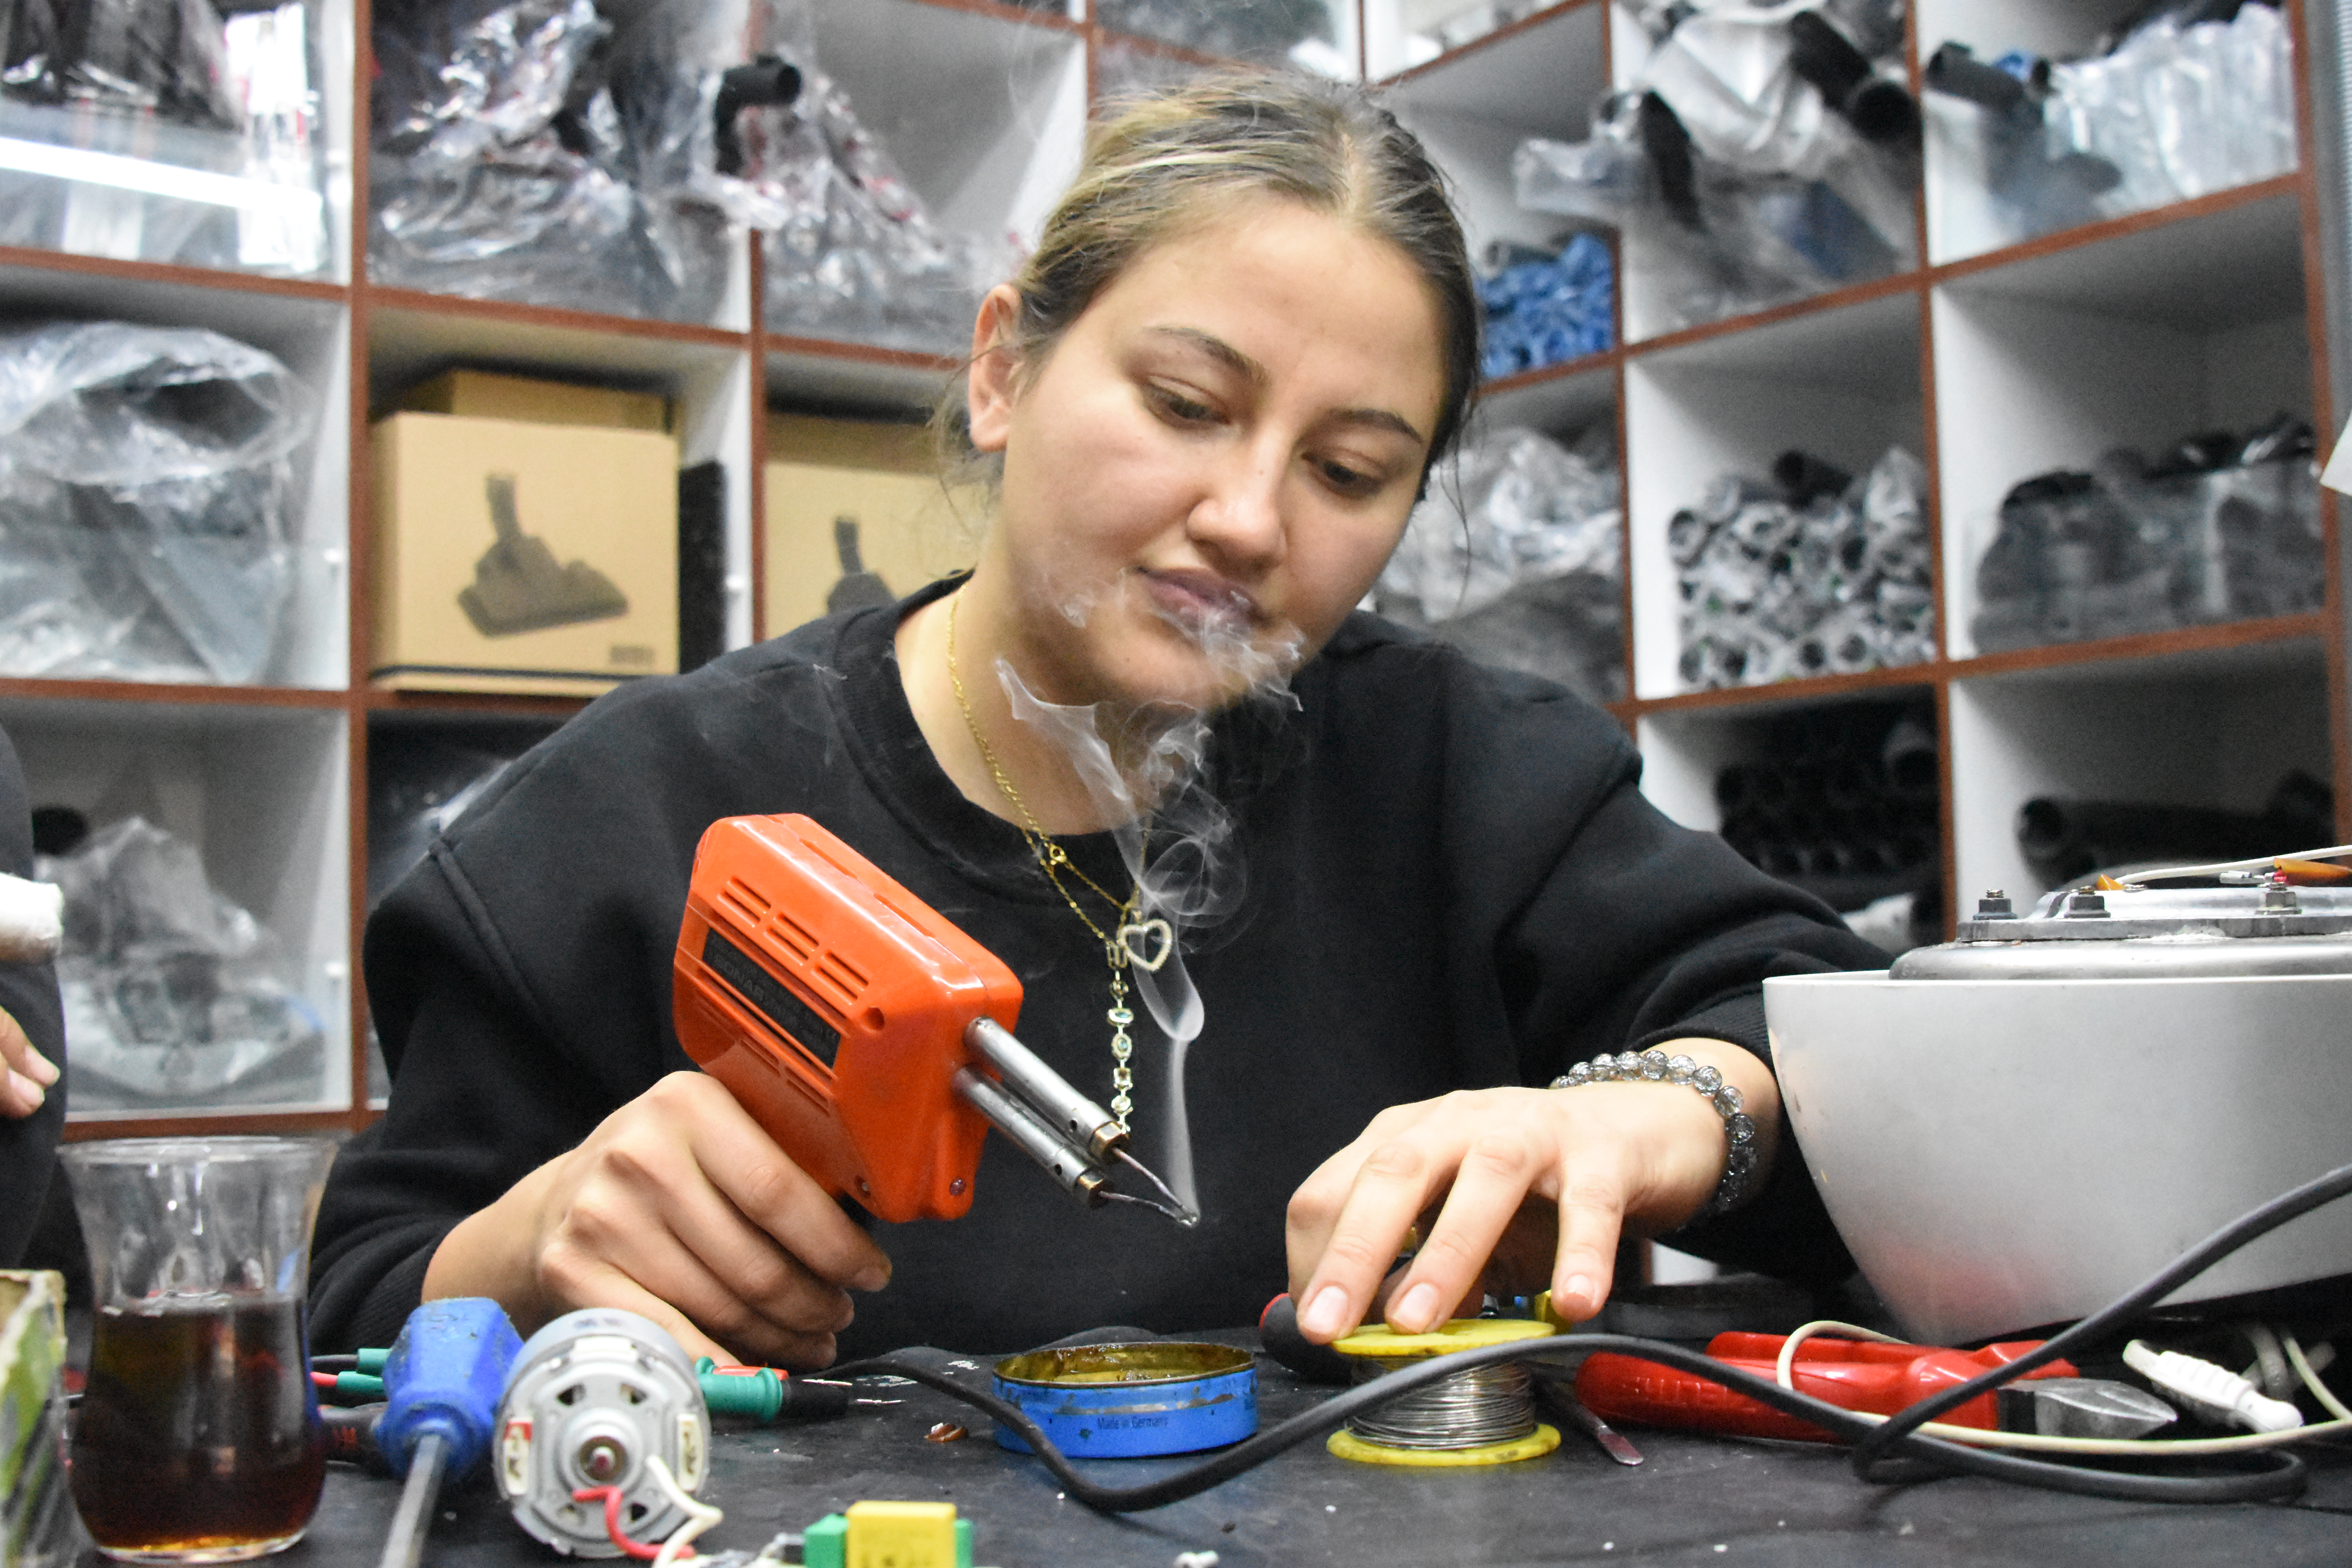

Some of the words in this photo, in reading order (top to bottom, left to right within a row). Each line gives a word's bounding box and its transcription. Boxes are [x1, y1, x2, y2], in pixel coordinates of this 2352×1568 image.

[1098, 1417, 1119, 1430] Made
[1121, 1418, 1130, 1428] in
[1131, 1416, 1168, 1428] Germany
